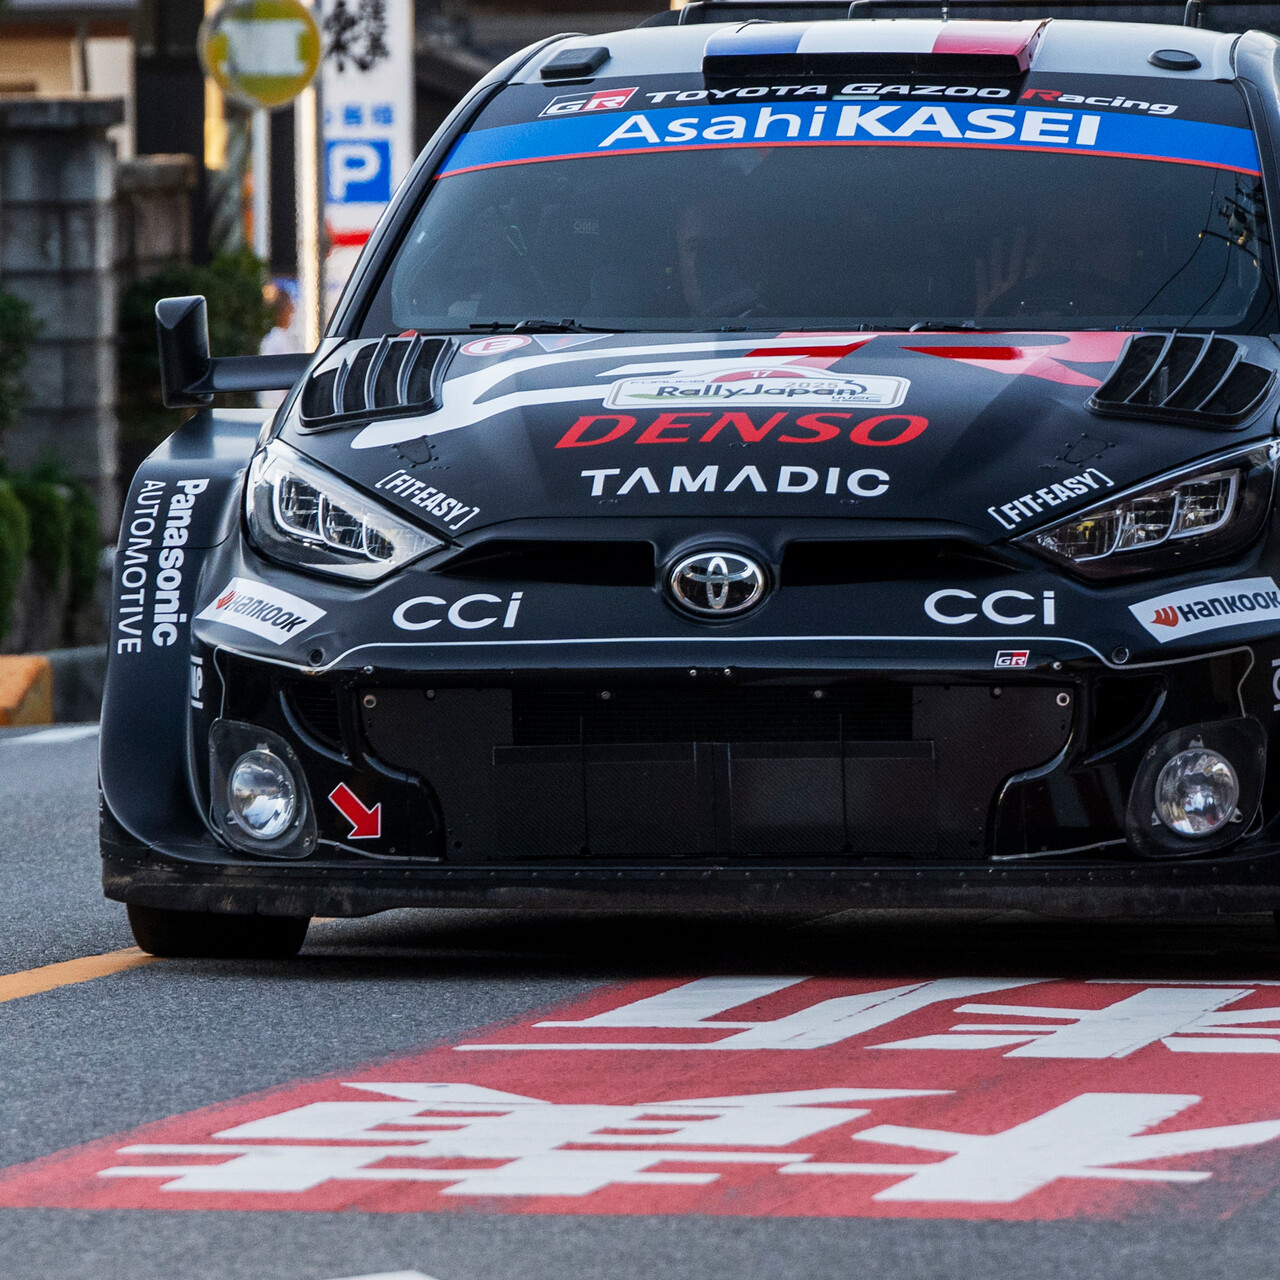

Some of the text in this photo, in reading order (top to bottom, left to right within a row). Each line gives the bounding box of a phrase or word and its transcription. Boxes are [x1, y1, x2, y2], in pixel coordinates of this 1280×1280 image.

[841, 83, 1010, 99] GAZOO
[1022, 88, 1179, 116] Racing
[329, 144, 381, 202] P
[750, 370, 773, 378] 17
[555, 412, 929, 448] DENSO
[581, 465, 890, 497] TAMADIC
[116, 479, 166, 655] AUTOMOTIVE
[152, 478, 209, 647] Panasonic
